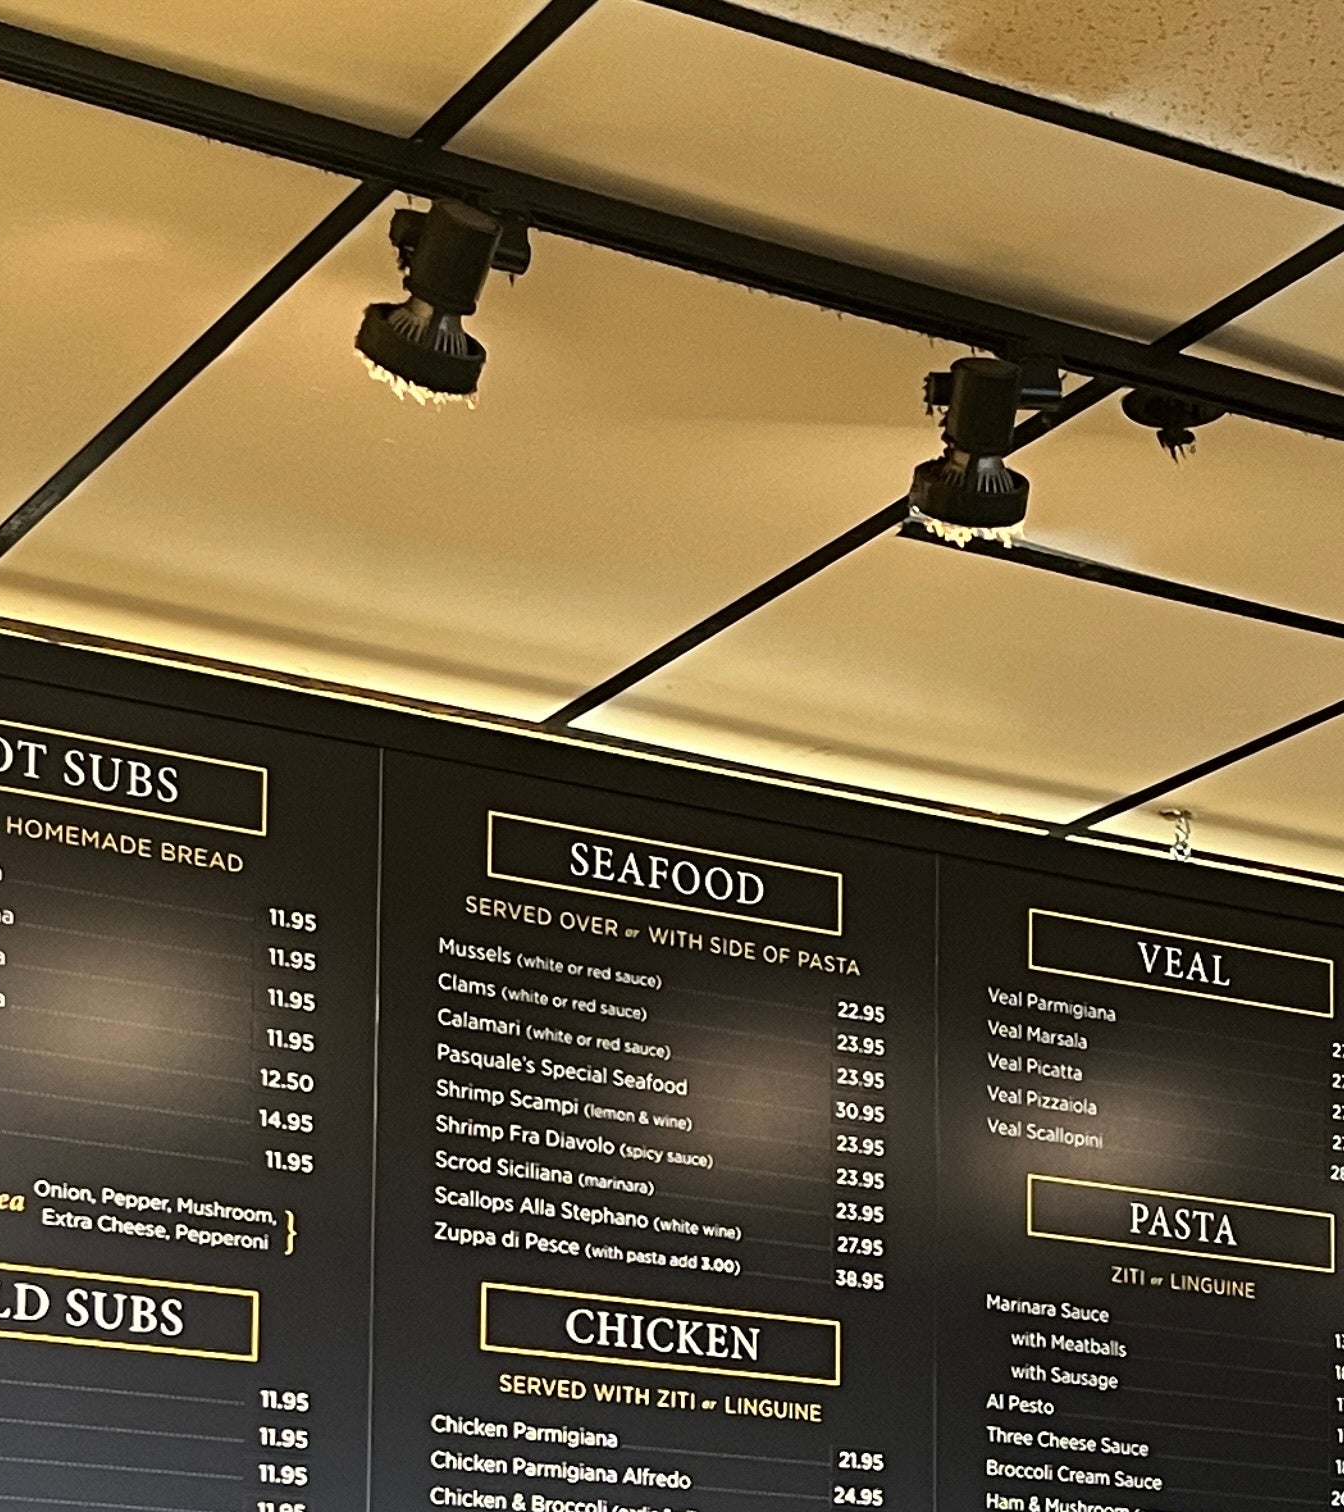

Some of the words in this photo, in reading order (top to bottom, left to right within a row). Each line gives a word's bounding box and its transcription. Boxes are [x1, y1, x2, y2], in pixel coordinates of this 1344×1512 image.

[64, 750, 178, 802] SUBS
[7, 816, 152, 857] HOMEMADE
[161, 843, 243, 872] BREAD
[571, 843, 763, 904] SEAFOOD
[270, 908, 316, 932] 11.95
[466, 896, 552, 925] SERVED
[560, 912, 617, 937] OVER
[625, 929, 640, 938] or
[649, 926, 702, 950] WITH
[710, 937, 755, 960] SIDE
[763, 946, 790, 963] OF
[799, 951, 860, 975] PASTA
[439, 937, 511, 964] Mussels
[517, 953, 563, 973] (white
[568, 964, 583, 975] or
[587, 967, 611, 980] red
[615, 971, 662, 990] sauce)
[838, 1002, 885, 1023] 22.95
[1138, 942, 1230, 986] VEAL
[988, 987, 1022, 1006] Veal
[1027, 993, 1116, 1021] Parmigiana
[988, 1020, 1022, 1039] Veal
[1027, 1026, 1087, 1049] Marsala
[438, 1043, 535, 1073] Pasquale's
[541, 1059, 607, 1083] Special
[613, 1069, 687, 1095] Seafood
[836, 1102, 884, 1122] 30.95
[259, 1109, 313, 1132] 14.95
[266, 1151, 313, 1173] 11.95
[34, 1180, 96, 1204] Onion,
[102, 1188, 172, 1213] Pepper,
[177, 1198, 276, 1225] Mushroom,
[1130, 1203, 1237, 1245] PASTA
[1112, 1266, 1144, 1285] ZITI
[1151, 1277, 1163, 1285] or
[1171, 1274, 1255, 1299] LINGUINE
[66, 1289, 183, 1335] SUBS
[987, 1294, 1056, 1317] Marinara
[1061, 1303, 1109, 1322] Sauce
[566, 1309, 760, 1360] CHICKEN
[260, 1390, 309, 1411] 11.95
[259, 1427, 308, 1448] 11.95
[431, 1415, 508, 1438] Chicken
[514, 1422, 617, 1448] Parmigiana
[839, 1451, 884, 1471] 21.95
[987, 1426, 1033, 1446] Three
[1037, 1431, 1096, 1452] Cheese
[1101, 1437, 1148, 1457] Sauce
